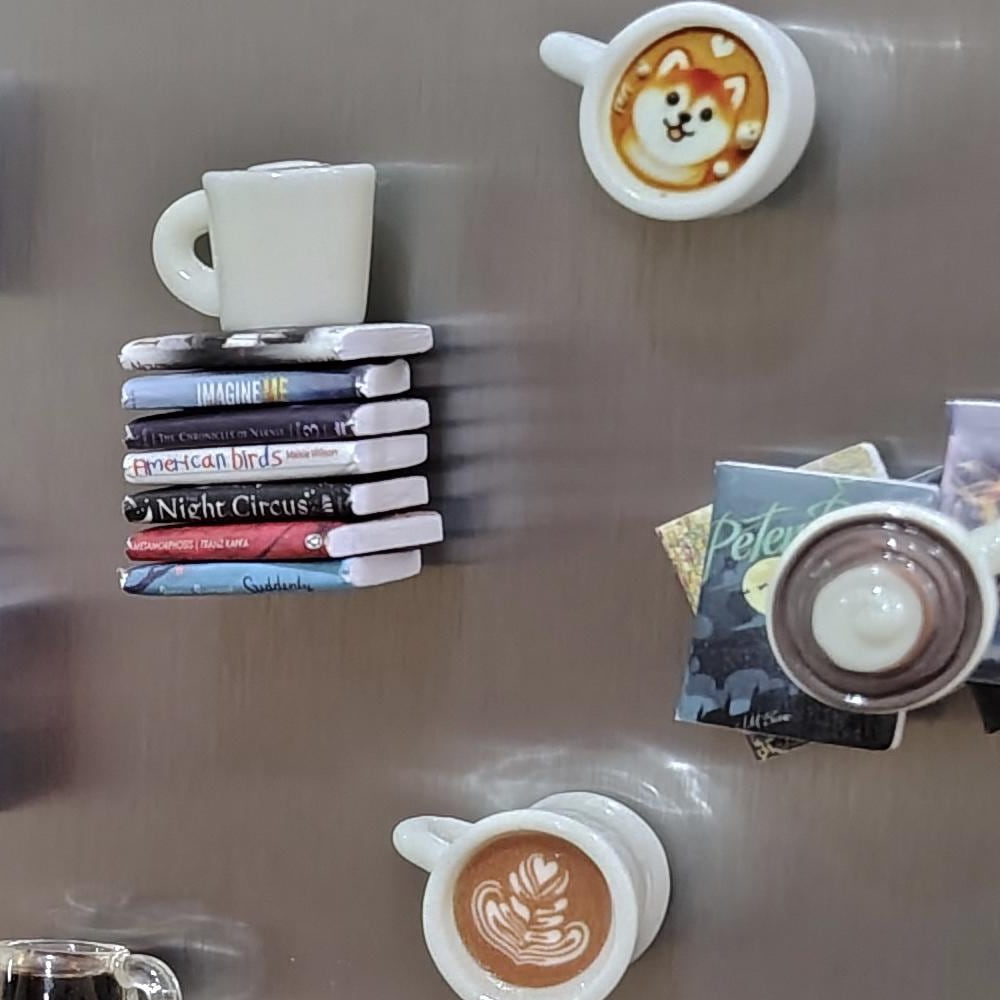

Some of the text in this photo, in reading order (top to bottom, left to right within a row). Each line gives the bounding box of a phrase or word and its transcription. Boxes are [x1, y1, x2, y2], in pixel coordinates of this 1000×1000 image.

[196, 378, 288, 407] IMAGINE ME
[157, 492, 308, 520] Night Circus
